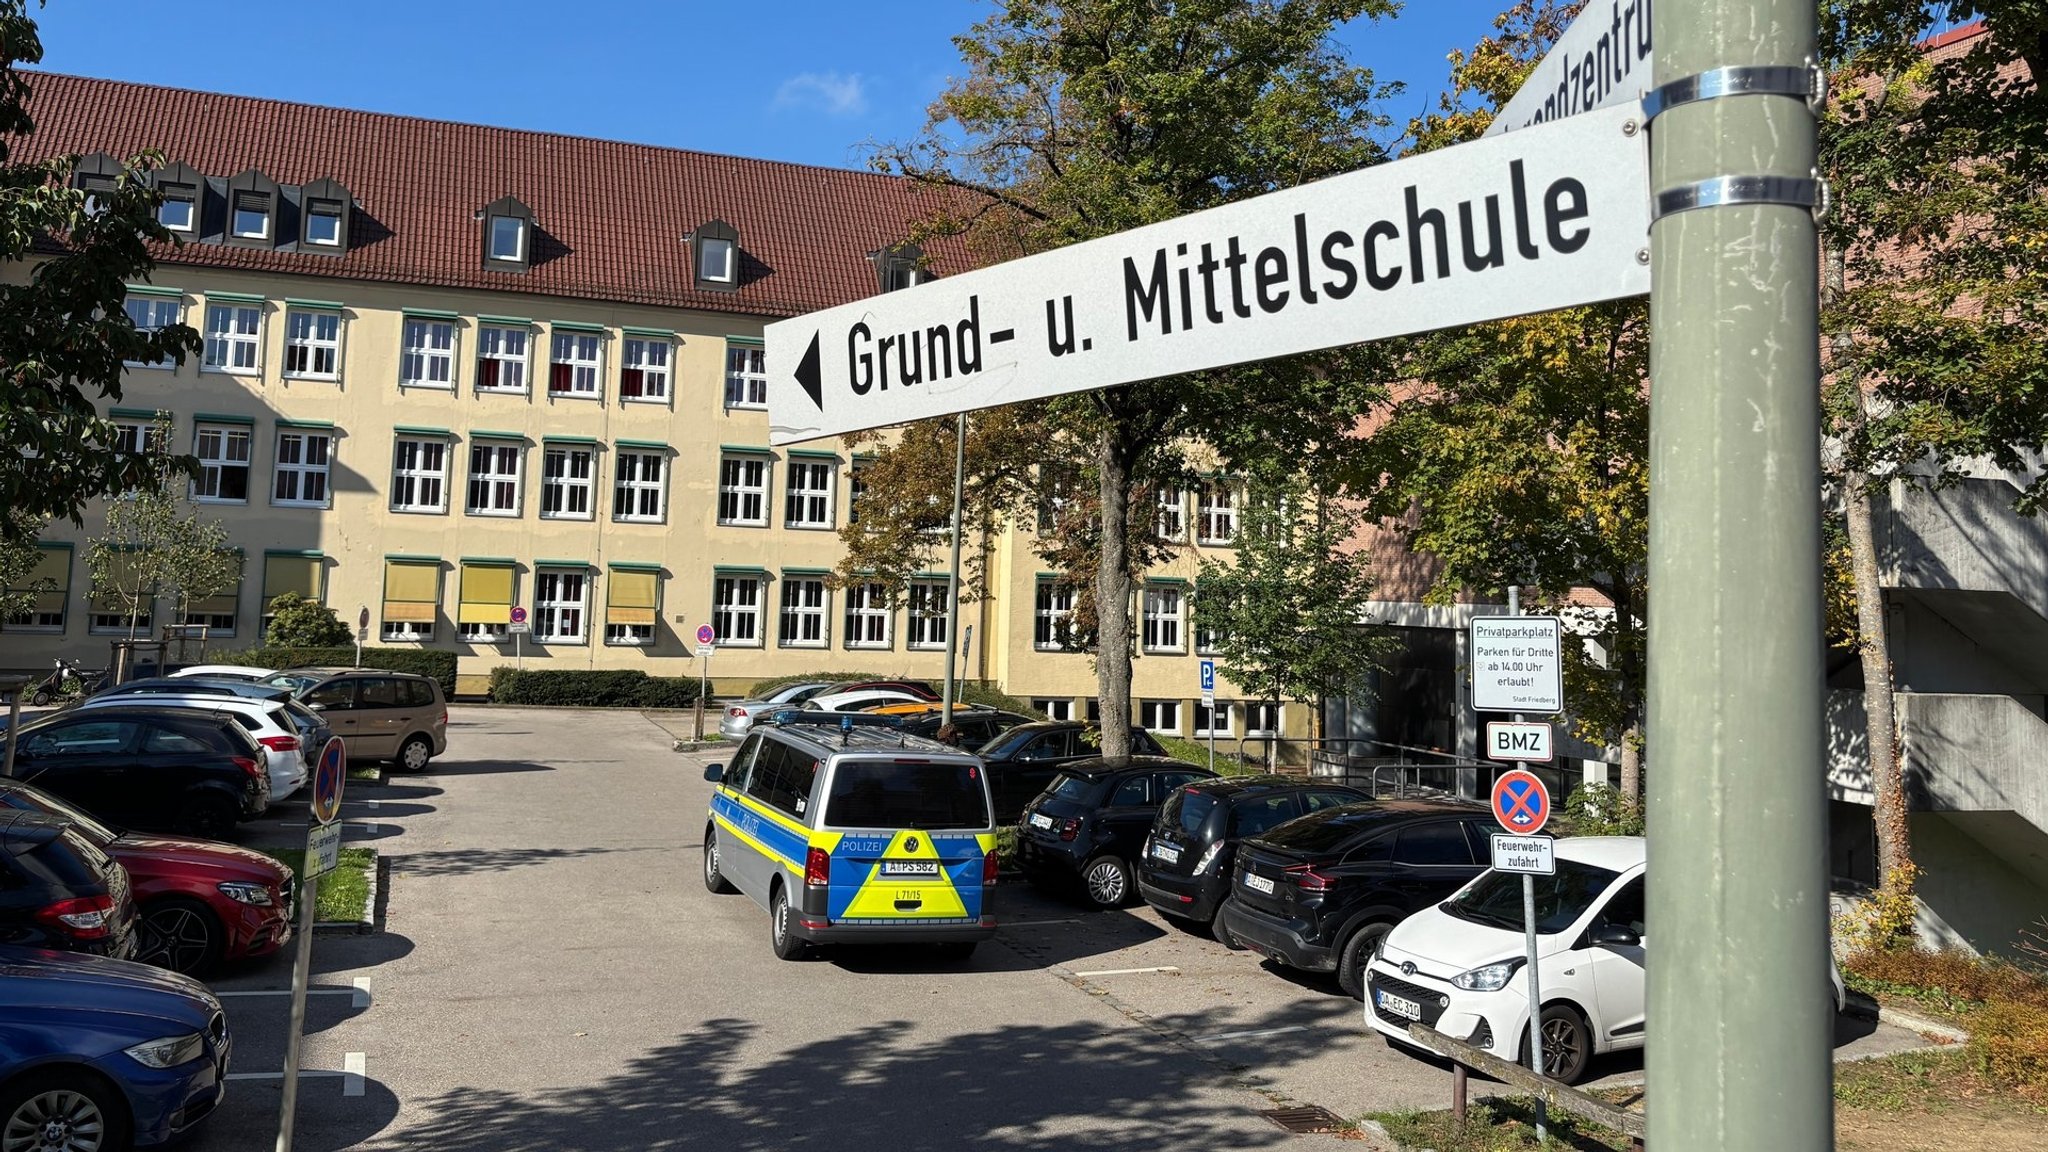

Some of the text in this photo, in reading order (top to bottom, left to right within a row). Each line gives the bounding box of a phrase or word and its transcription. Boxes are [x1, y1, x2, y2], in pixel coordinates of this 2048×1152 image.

[848, 158, 1591, 396] Grund- u. Mittelschule
[1476, 625, 1553, 639] Privatparkplatz
[1477, 646, 1554, 658] Parken für Dritte
[1487, 662, 1544, 673] ab 14.00 Uhr
[1497, 677, 1534, 687] erlaubt!
[1512, 695, 1556, 705] Stadt Friedberg
[1497, 731, 1541, 751] BMZ
[842, 841, 883, 852] POLIZEI
[1496, 839, 1548, 853] Feuerwehr-
[1507, 856, 1540, 868] zufahrt
[901, 890, 921, 900] 71/15
